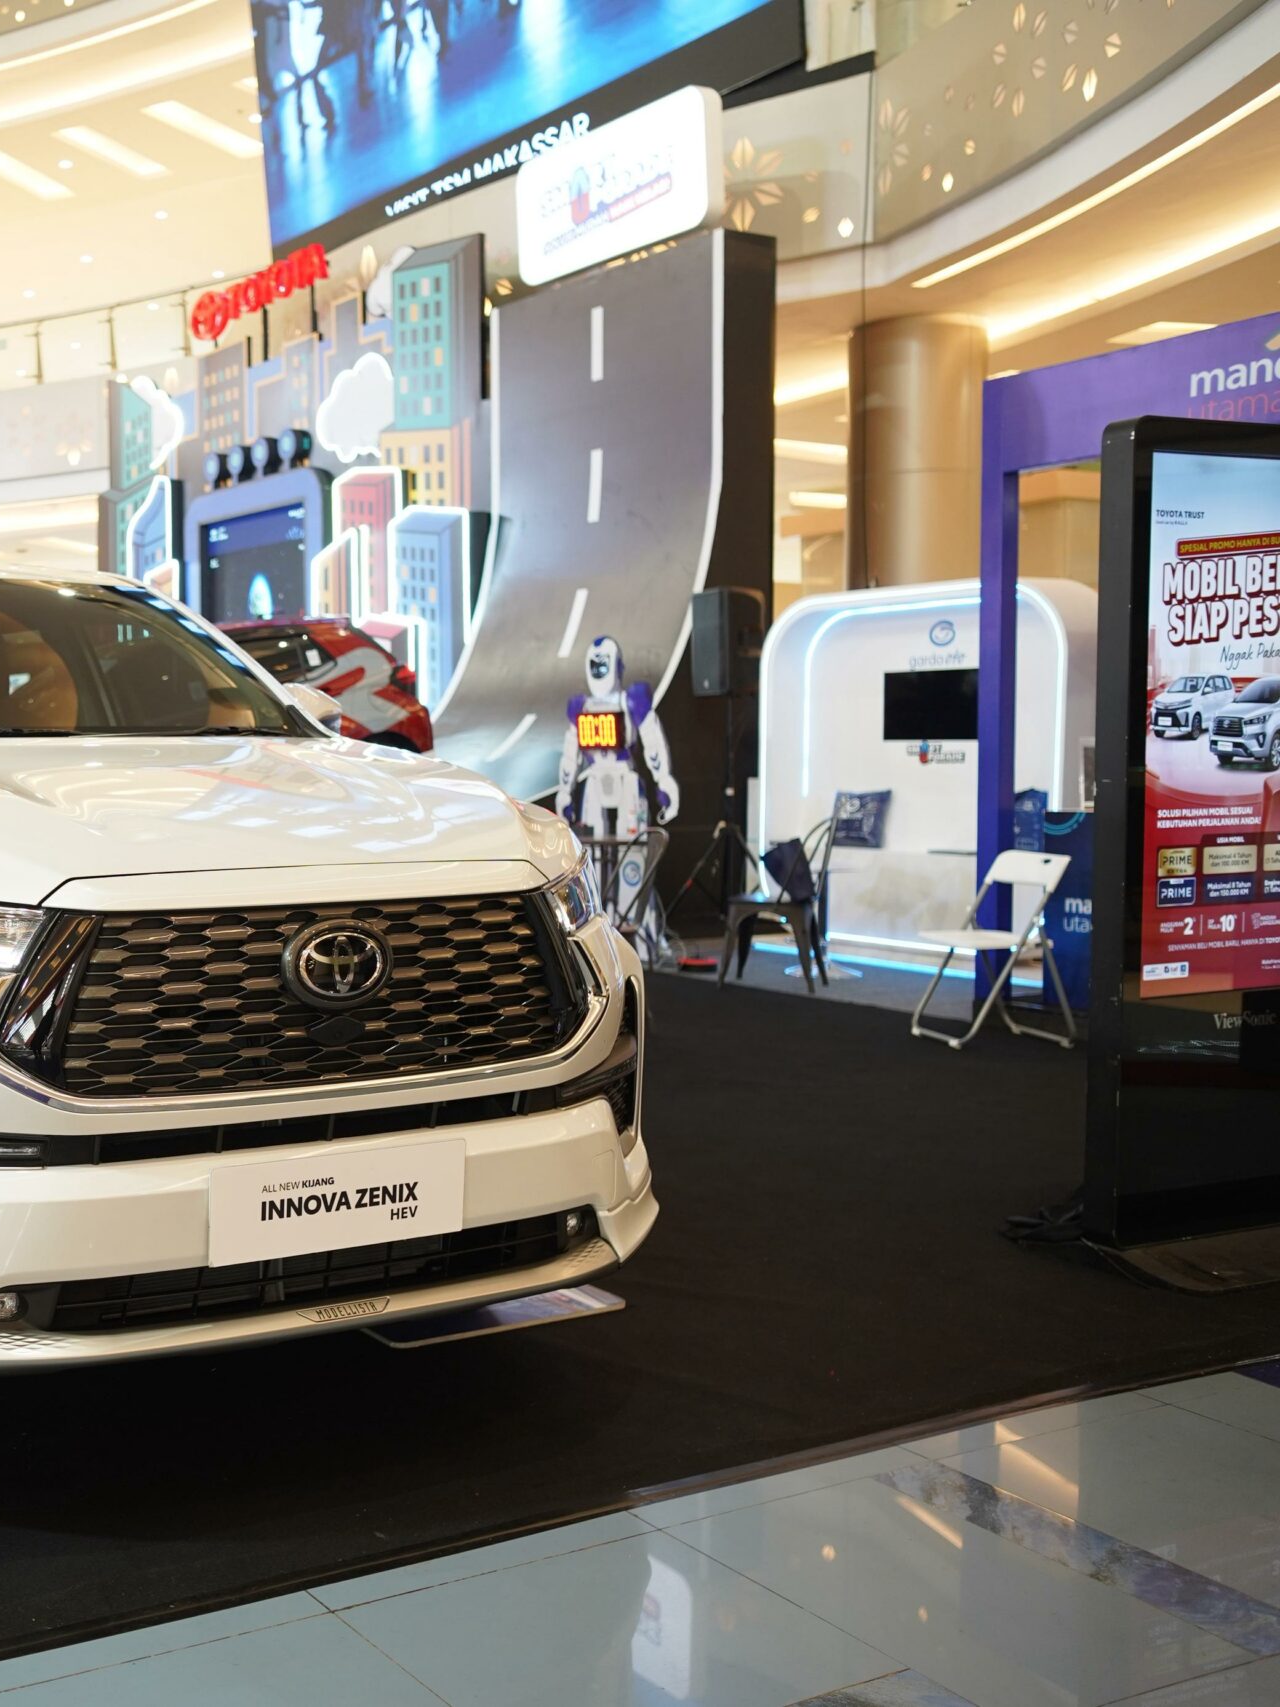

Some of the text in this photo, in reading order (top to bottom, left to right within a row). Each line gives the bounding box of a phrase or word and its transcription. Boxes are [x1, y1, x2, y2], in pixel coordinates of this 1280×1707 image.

[473, 112, 590, 179] MAKASSAR
[1156, 509, 1205, 519] TOYOTA TRUST
[1180, 542, 1208, 553] SPESIAL
[1209, 540, 1235, 550] PROMO
[1236, 538, 1260, 548] HANYA
[1262, 536, 1270, 545] DI
[1163, 558, 1241, 604] MOBIL
[1168, 595, 1280, 646] SIAP PES
[1220, 643, 1253, 671] Nggak
[1157, 806, 1253, 818] SOLUSI PILIHAN MOBIL SESUAI
[1157, 816, 1262, 828] KEBUTUHAN PERJALANAN ANDA!
[1162, 855, 1192, 866] PRIME
[1160, 887, 1192, 899] PRIME
[1207, 882, 1231, 890] Maksimal
[1062, 915, 1093, 933] uta
[1183, 917, 1194, 936] 2
[1220, 914, 1235, 932] 10
[261, 1177, 335, 1194] ALL NEW KIJANG
[260, 1181, 419, 1221] INNOVA ZENIX
[390, 1205, 418, 1221] HEV
[315, 1301, 378, 1321] MODELLISTA
